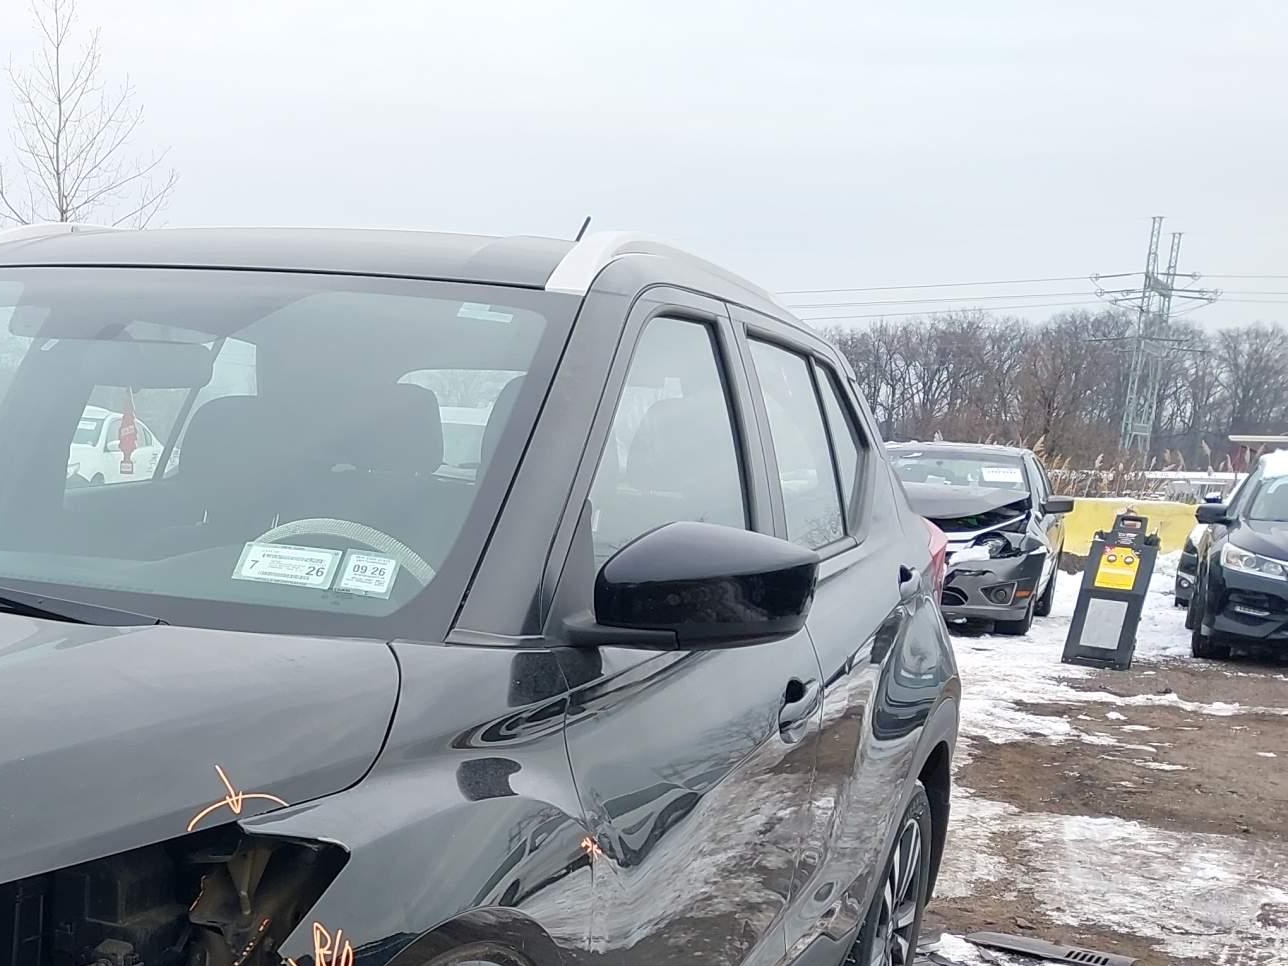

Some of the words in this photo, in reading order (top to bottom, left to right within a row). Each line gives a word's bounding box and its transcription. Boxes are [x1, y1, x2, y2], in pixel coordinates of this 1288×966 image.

[249, 559, 260, 569] 7
[305, 566, 325, 577] 26
[352, 563, 368, 574] 09
[370, 566, 387, 577] 26
